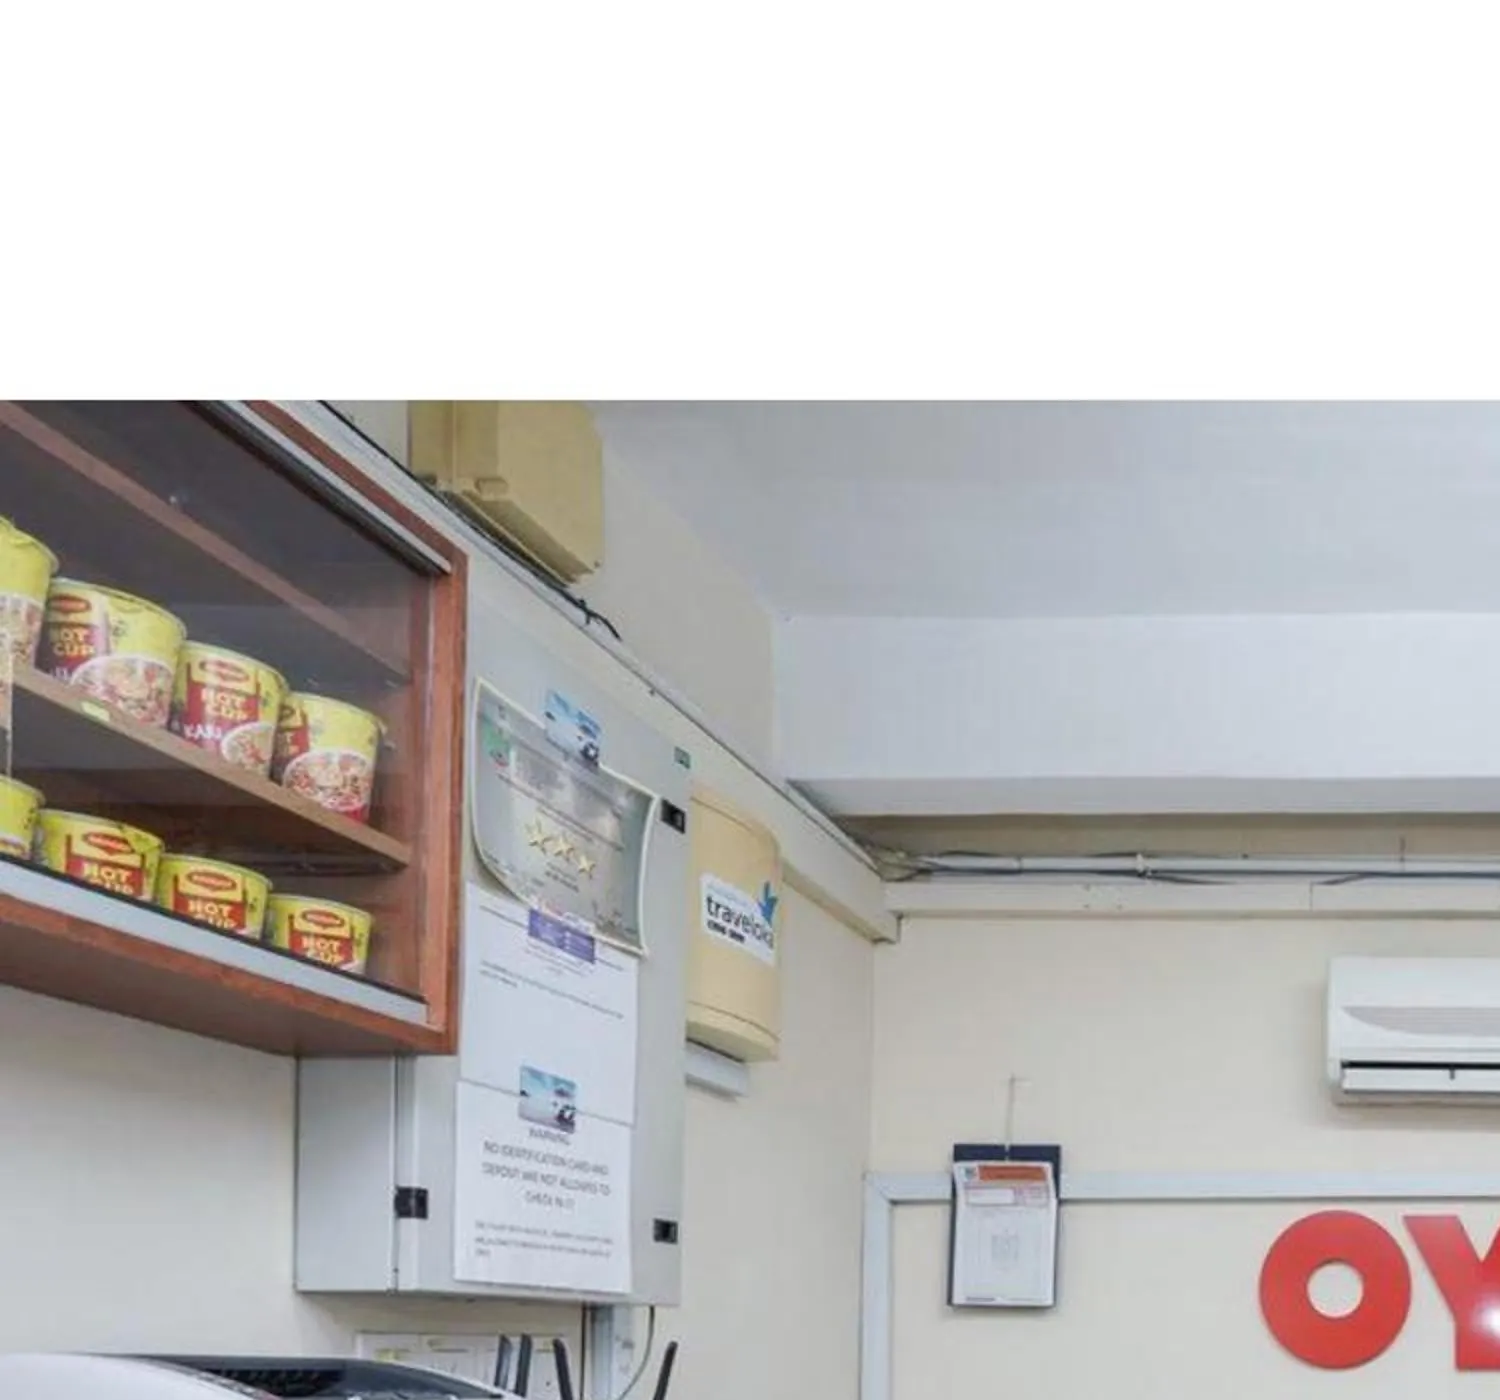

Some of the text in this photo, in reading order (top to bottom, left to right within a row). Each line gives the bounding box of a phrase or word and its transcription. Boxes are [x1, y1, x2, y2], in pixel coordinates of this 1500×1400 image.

[82, 859, 132, 884] HOT
[188, 899, 233, 920] HOT
[302, 935, 340, 956] HOT
